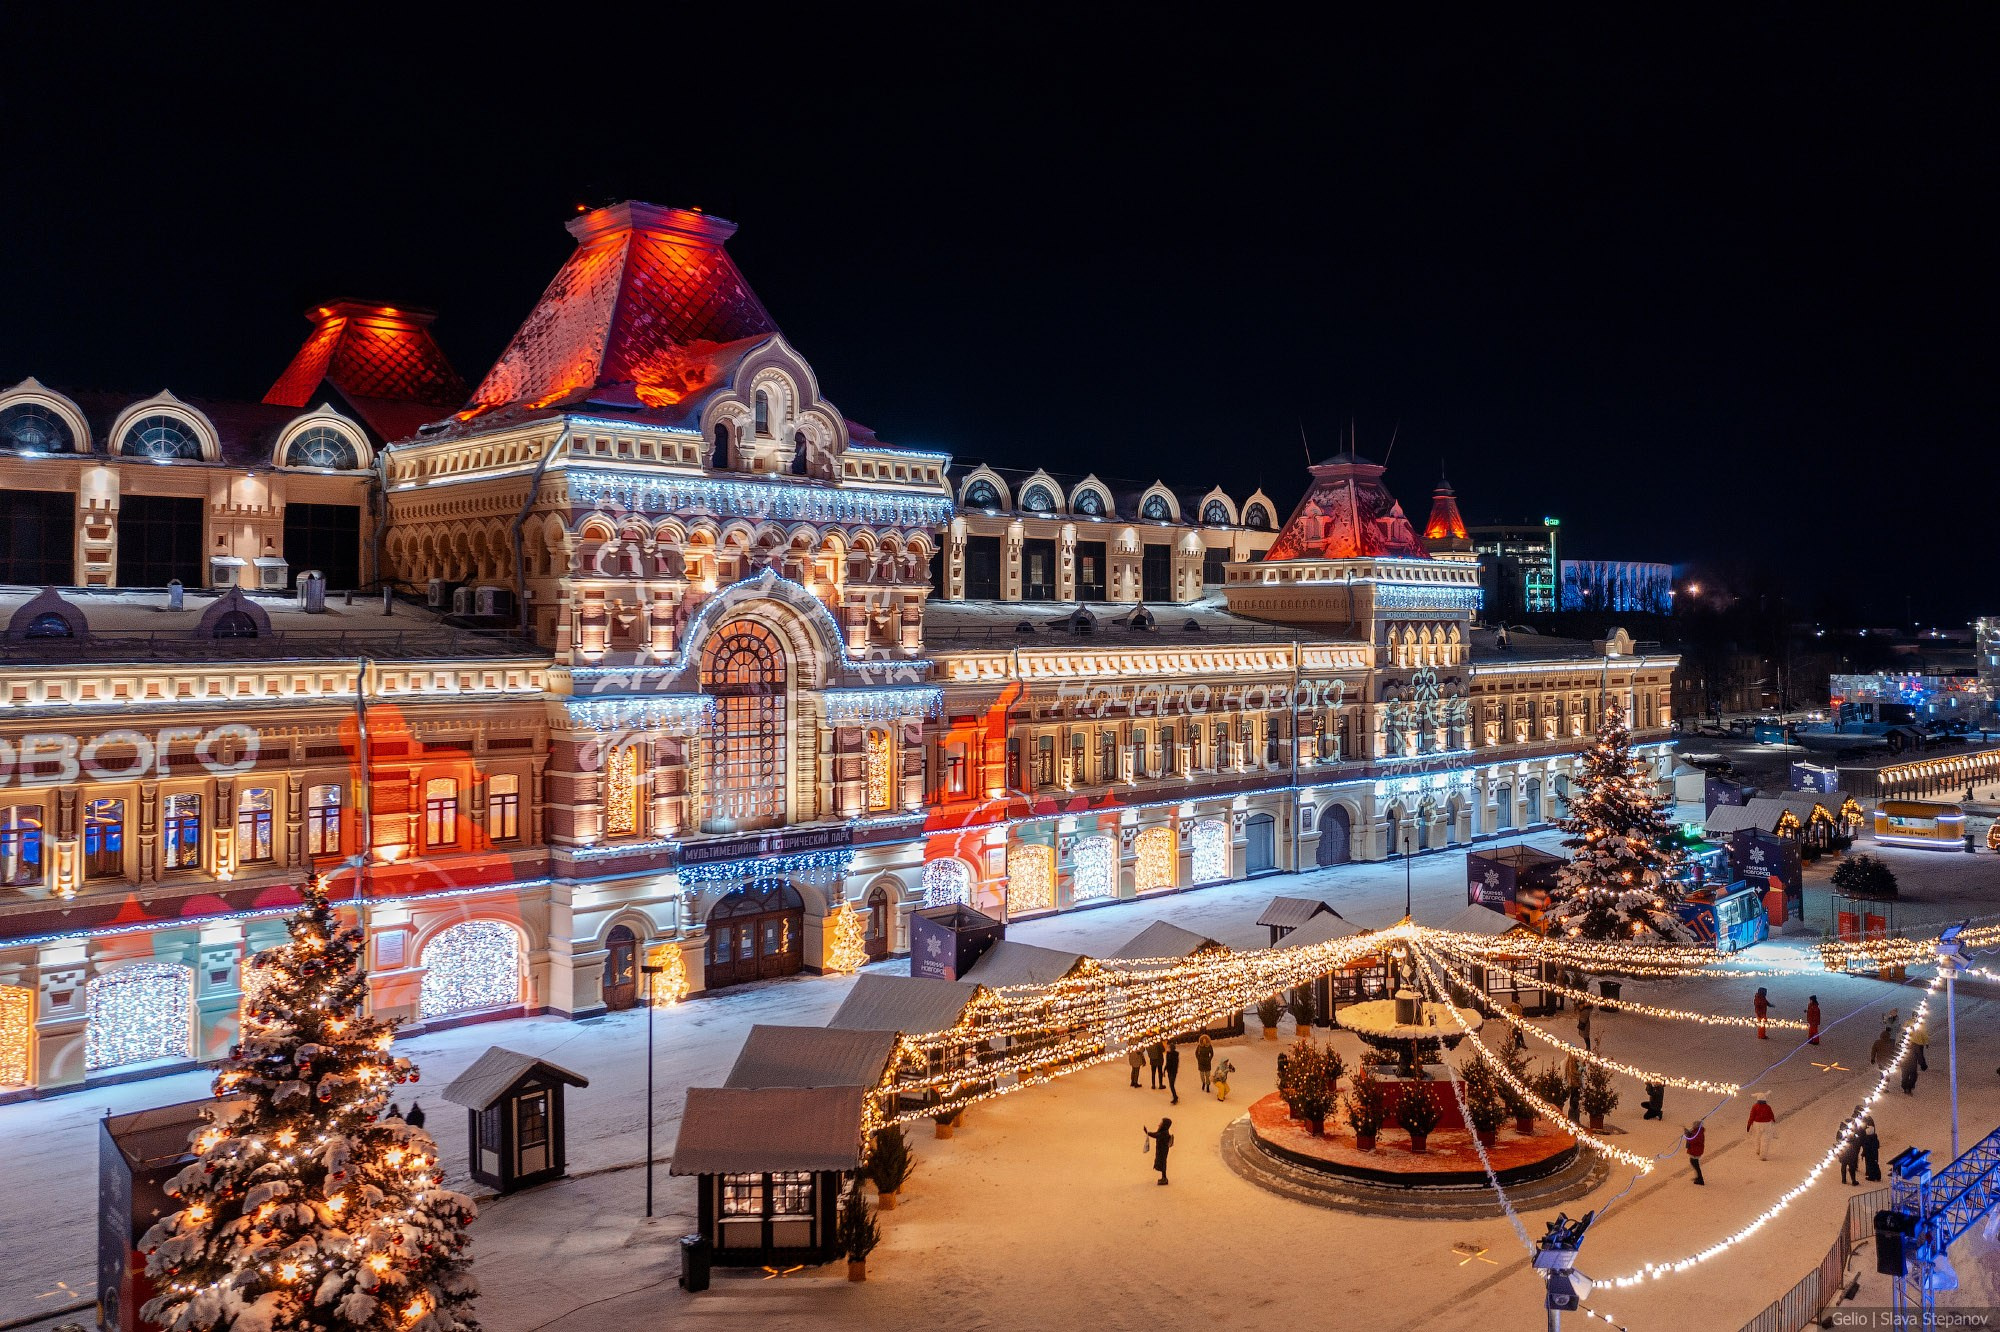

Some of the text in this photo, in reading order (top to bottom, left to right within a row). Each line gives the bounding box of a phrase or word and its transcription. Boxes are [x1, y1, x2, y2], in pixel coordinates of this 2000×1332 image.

[685, 831, 850, 861] МУЛЬТИМЕДИЙНЫЙ ИСТОРИЧЕСКИЙ ПАРК
[921, 966, 947, 976] НОВГОРОД
